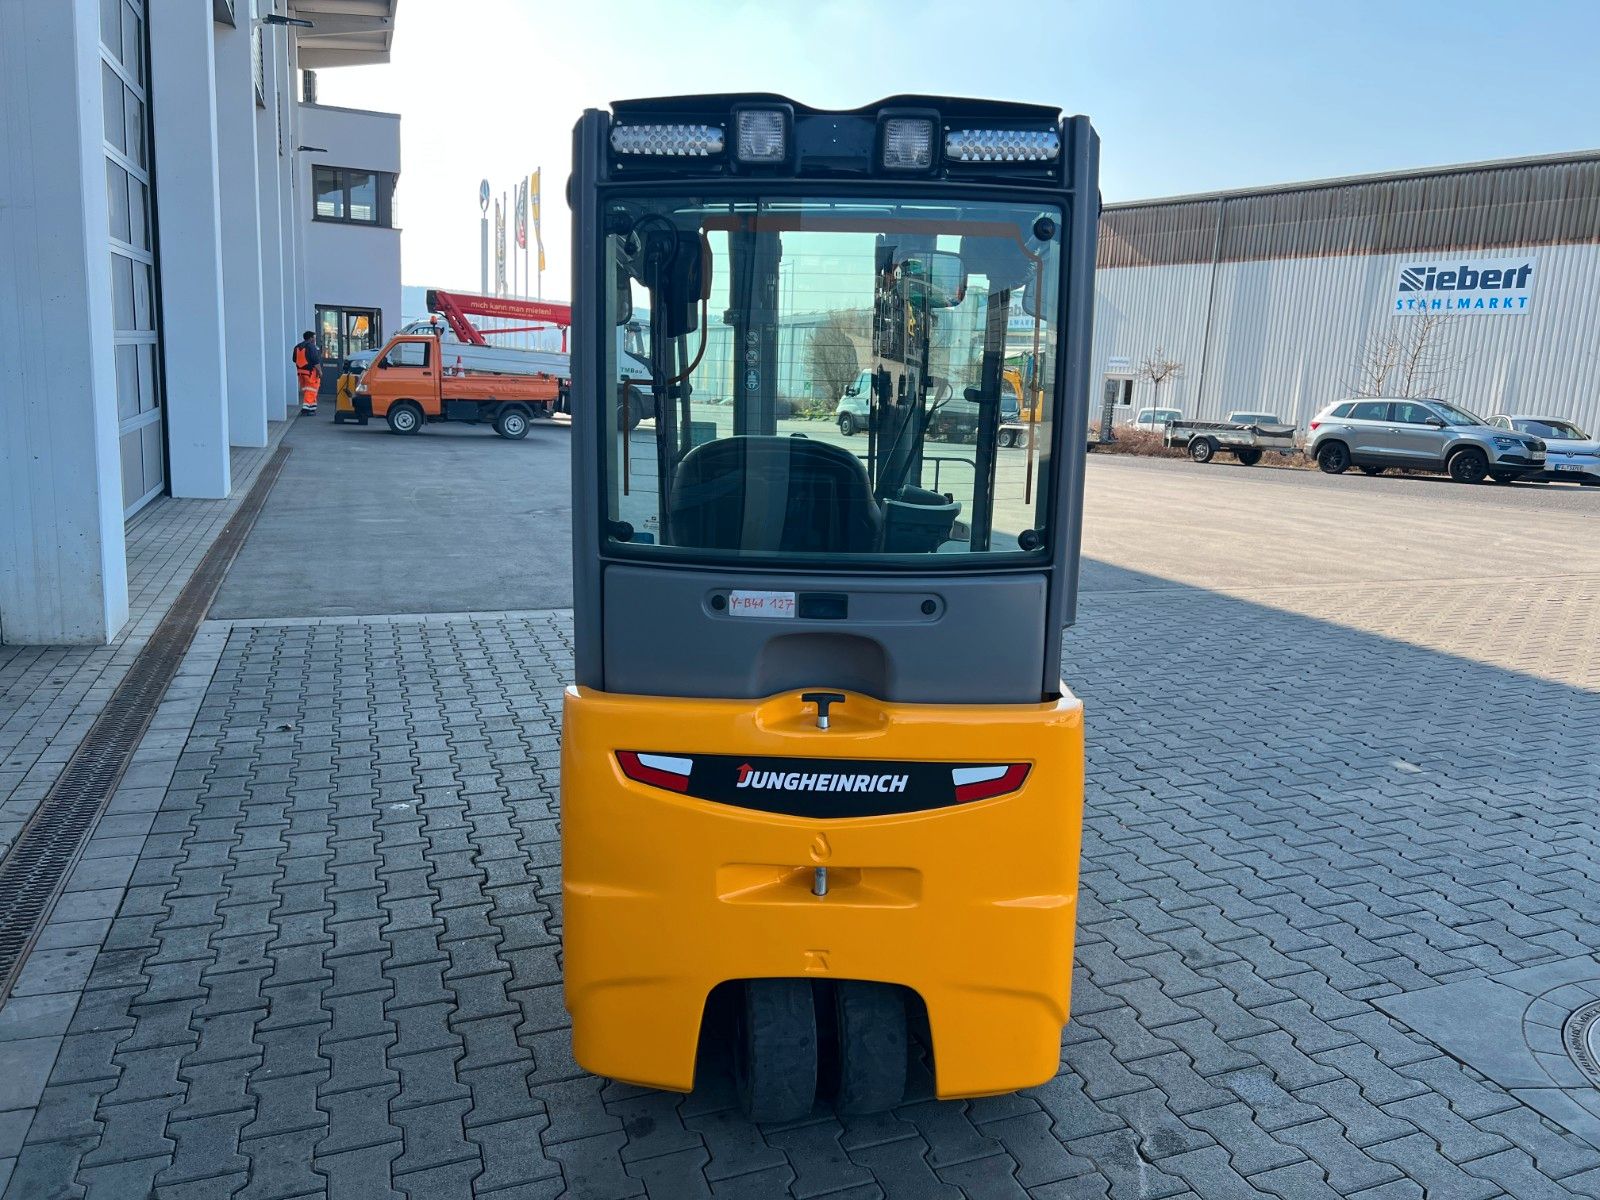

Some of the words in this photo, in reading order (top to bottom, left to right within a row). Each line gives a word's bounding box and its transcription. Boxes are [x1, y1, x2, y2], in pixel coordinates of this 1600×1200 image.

[1399, 263, 1533, 292] Siebert
[470, 301, 489, 309] mich
[489, 302, 508, 311] kann
[1396, 297, 1528, 311] STAHLMARKT
[769, 598, 795, 611] 127
[736, 769, 909, 793] JUNGHEINRICH
